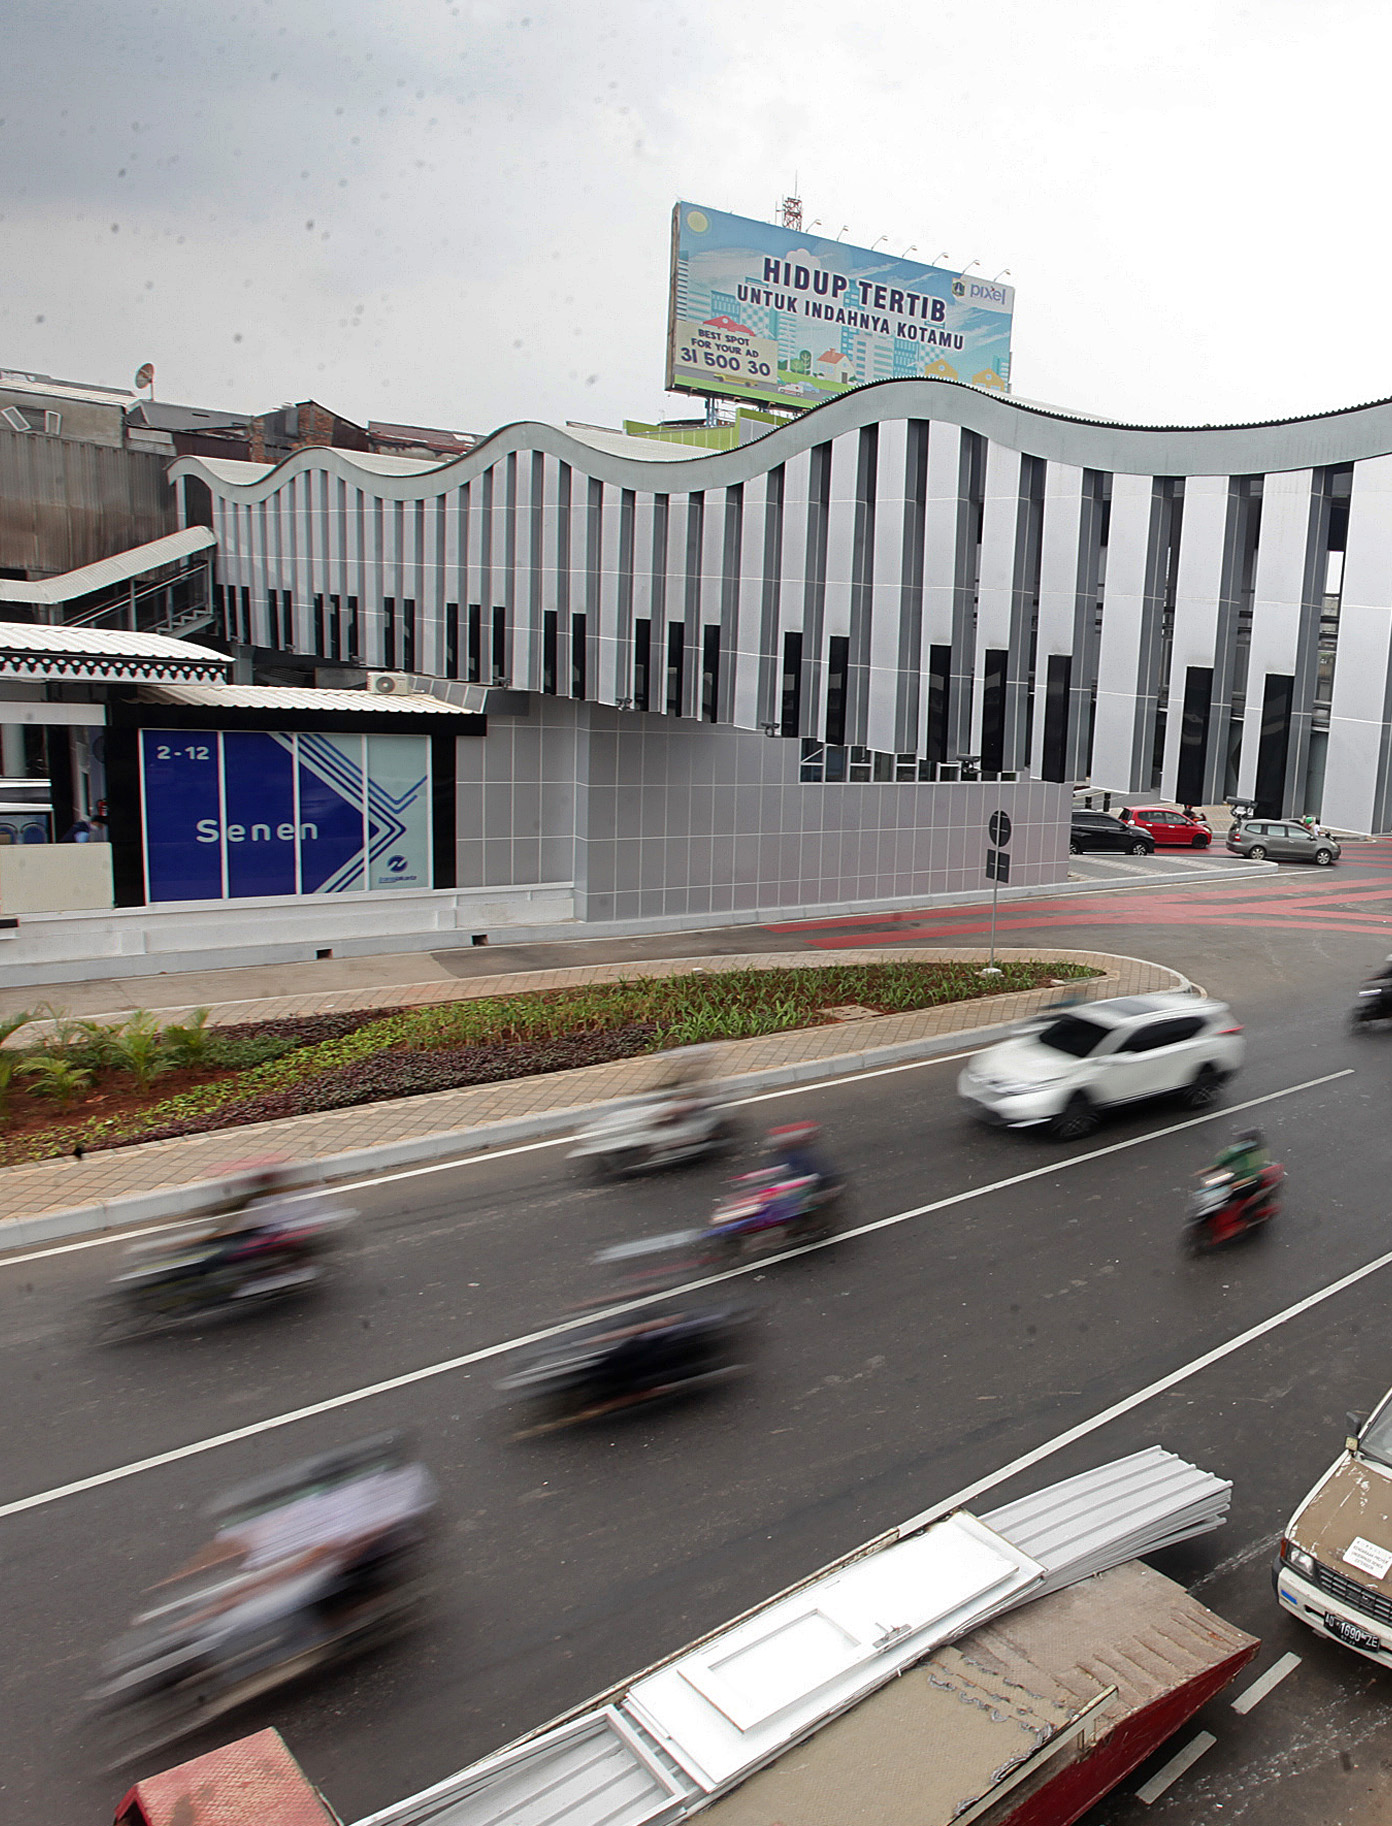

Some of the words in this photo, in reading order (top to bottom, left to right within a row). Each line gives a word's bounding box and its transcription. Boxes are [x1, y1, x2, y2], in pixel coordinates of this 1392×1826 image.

[763, 257, 847, 298] HIDUP
[858, 281, 945, 323] TERTIB
[970, 284, 1006, 305] pixel
[737, 284, 798, 313] UNTUK
[804, 300, 890, 335] INDAHNYA
[897, 322, 964, 350] KOTAMU
[691, 338, 711, 349] FOR
[715, 343, 742, 355] YOUR
[746, 349, 759, 358] AD
[698, 329, 721, 340] BEST
[724, 335, 750, 346] SPOT
[703, 351, 740, 371] 500
[747, 360, 771, 376] 30
[156, 745, 210, 760] 2-12
[195, 818, 318, 843] Senen
[1340, 1621, 1361, 1642] 1690
